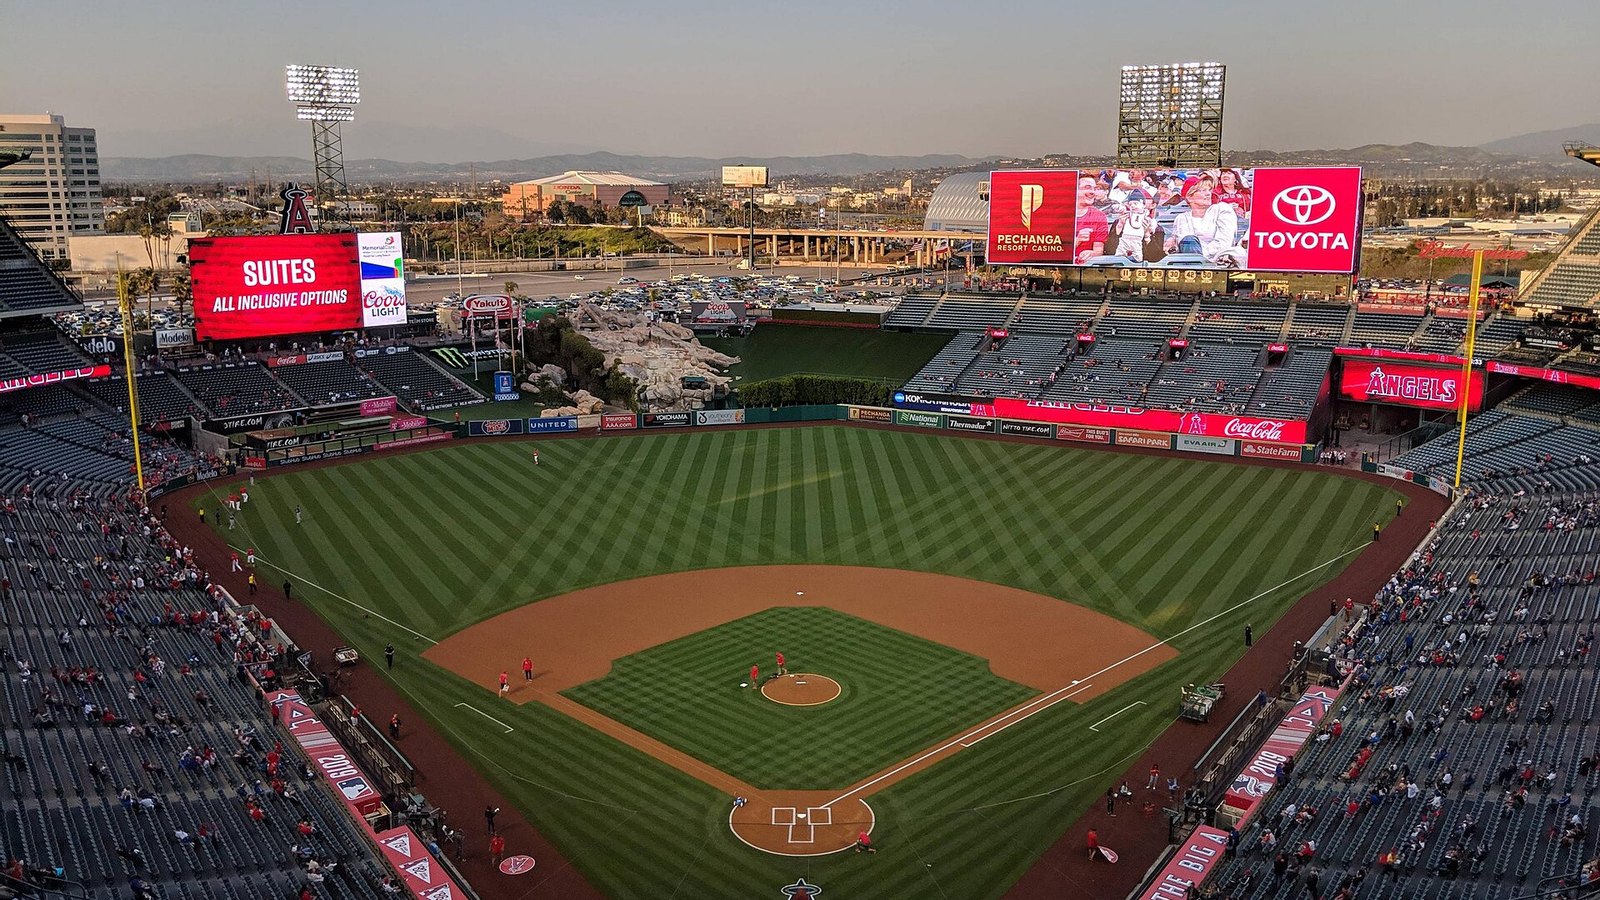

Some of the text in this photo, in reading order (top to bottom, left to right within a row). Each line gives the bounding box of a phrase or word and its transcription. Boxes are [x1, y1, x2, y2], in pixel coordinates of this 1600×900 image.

[997, 234, 1062, 245] PECHANGA
[1255, 231, 1349, 250] TOYOTA
[243, 258, 316, 286] SUITES
[213, 289, 348, 312] ALL INCLUSIVE OPTIONS
[363, 290, 405, 309] Coors
[473, 299, 506, 308] Yakult
[371, 306, 400, 317] LIGHT
[84, 337, 115, 354] delo
[161, 333, 189, 343] Modelo
[1365, 367, 1456, 402] ANGELS
[861, 410, 890, 418] PECHANGA
[909, 413, 939, 423] National
[950, 420, 986, 430] Thermador
[1224, 418, 1286, 440] Coca-Cola
[1118, 436, 1146, 444] SAFARI
[197, 470, 217, 480] Modelo
[318, 754, 358, 779] 2019
[1250, 751, 1286, 778] 2019
[1150, 832, 1227, 900] THE BIG A
